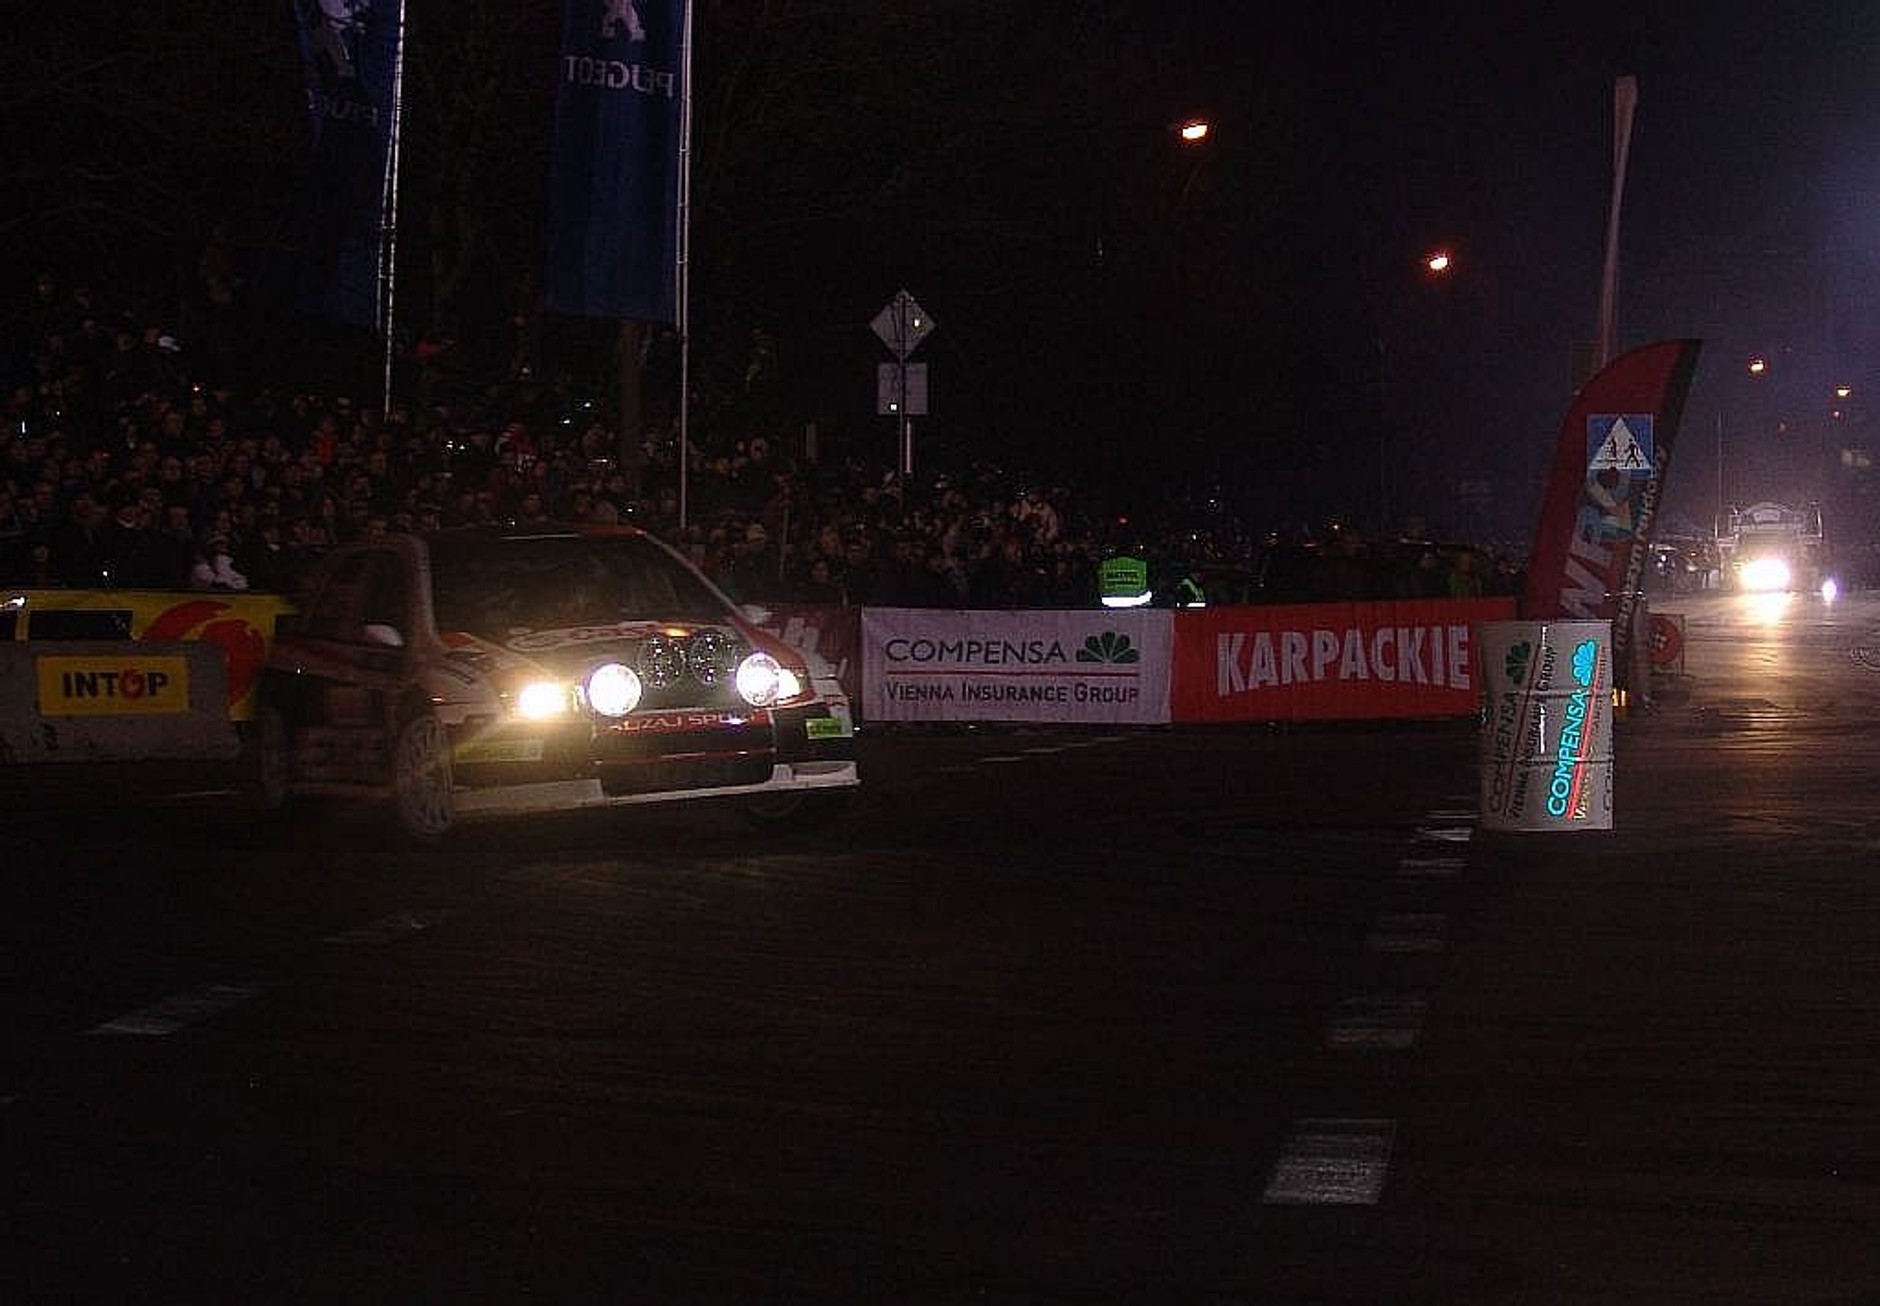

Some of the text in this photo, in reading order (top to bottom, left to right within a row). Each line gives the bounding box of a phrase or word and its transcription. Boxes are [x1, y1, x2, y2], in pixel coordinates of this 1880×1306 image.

[886, 638, 1067, 664] COMPENSA
[1217, 624, 1470, 696] KARPACKIE
[62, 669, 168, 701] INTOP
[886, 682, 1139, 703] VIENNA INSURANCE GROUP
[1545, 690, 1589, 817] COMPENSA
